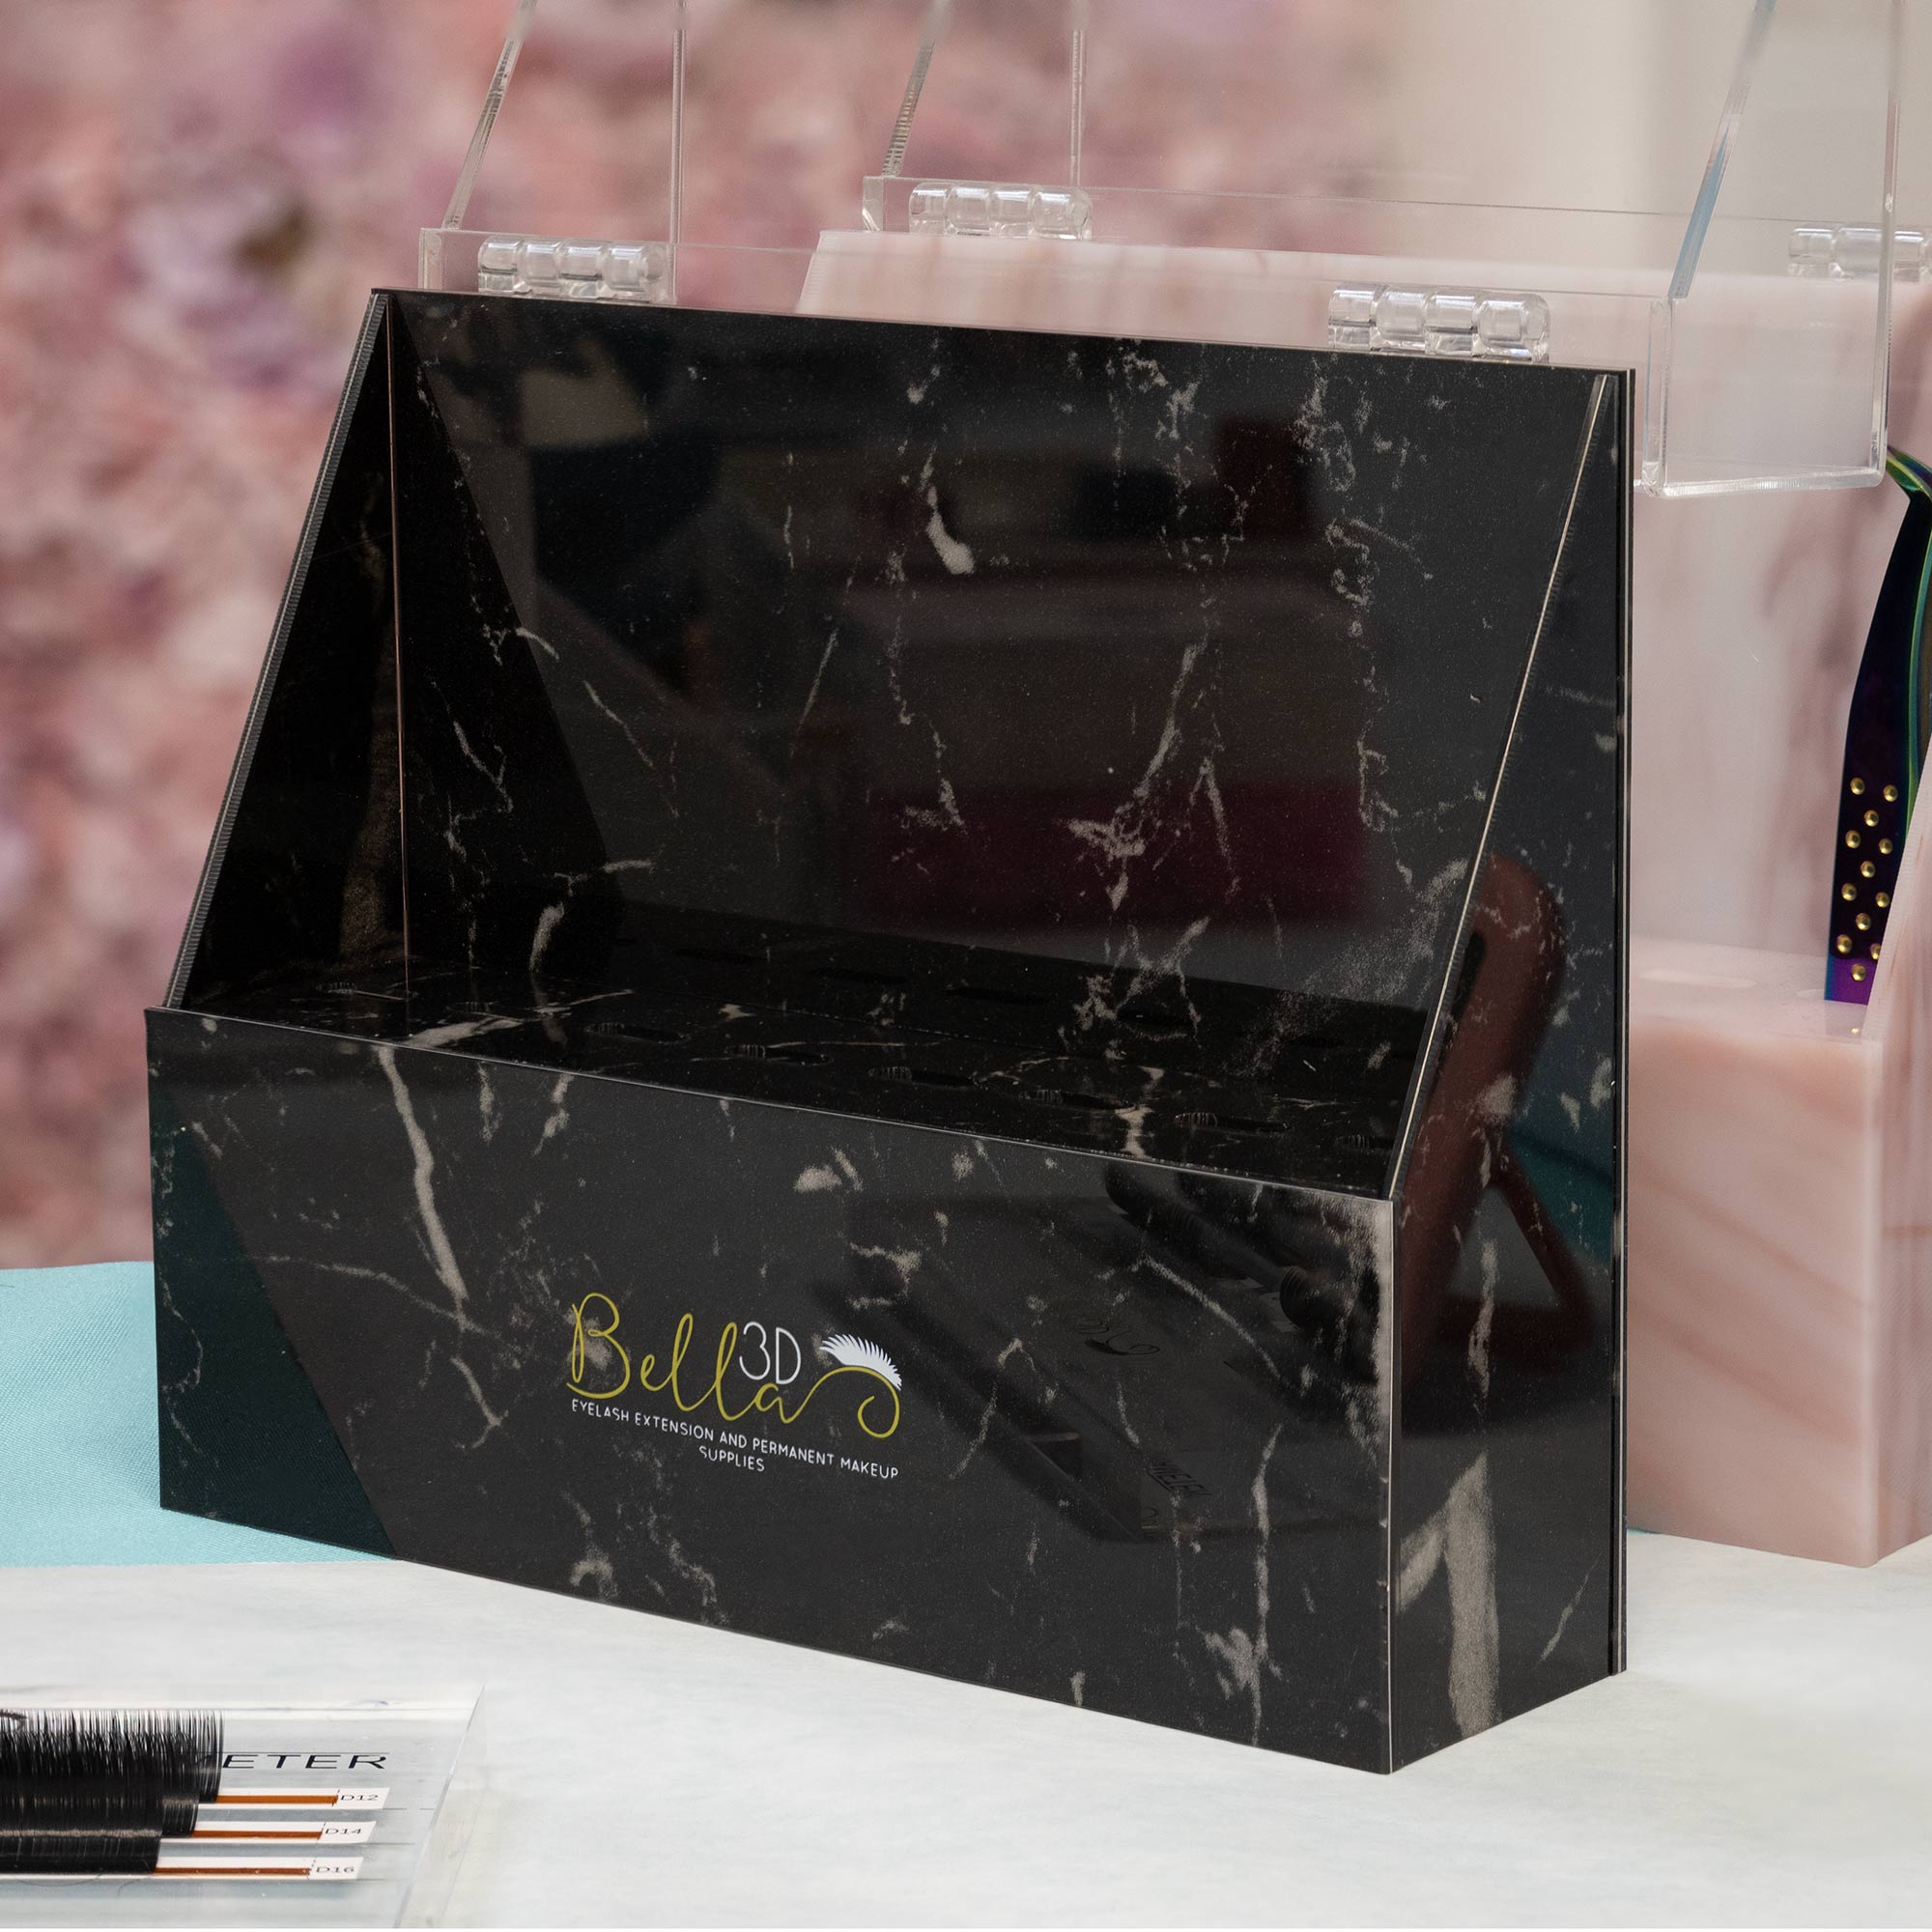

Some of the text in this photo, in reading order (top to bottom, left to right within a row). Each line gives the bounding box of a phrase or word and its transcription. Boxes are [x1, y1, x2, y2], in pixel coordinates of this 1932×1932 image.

[566, 1293, 821, 1424] Bella
[739, 1321, 801, 1384] 3D
[572, 1399, 898, 1479] EYELASH EXTENSION AND PERMANENT MAKEUP
[698, 1446, 765, 1472] SUPPLIES
[193, 1754, 386, 1769] ETER
